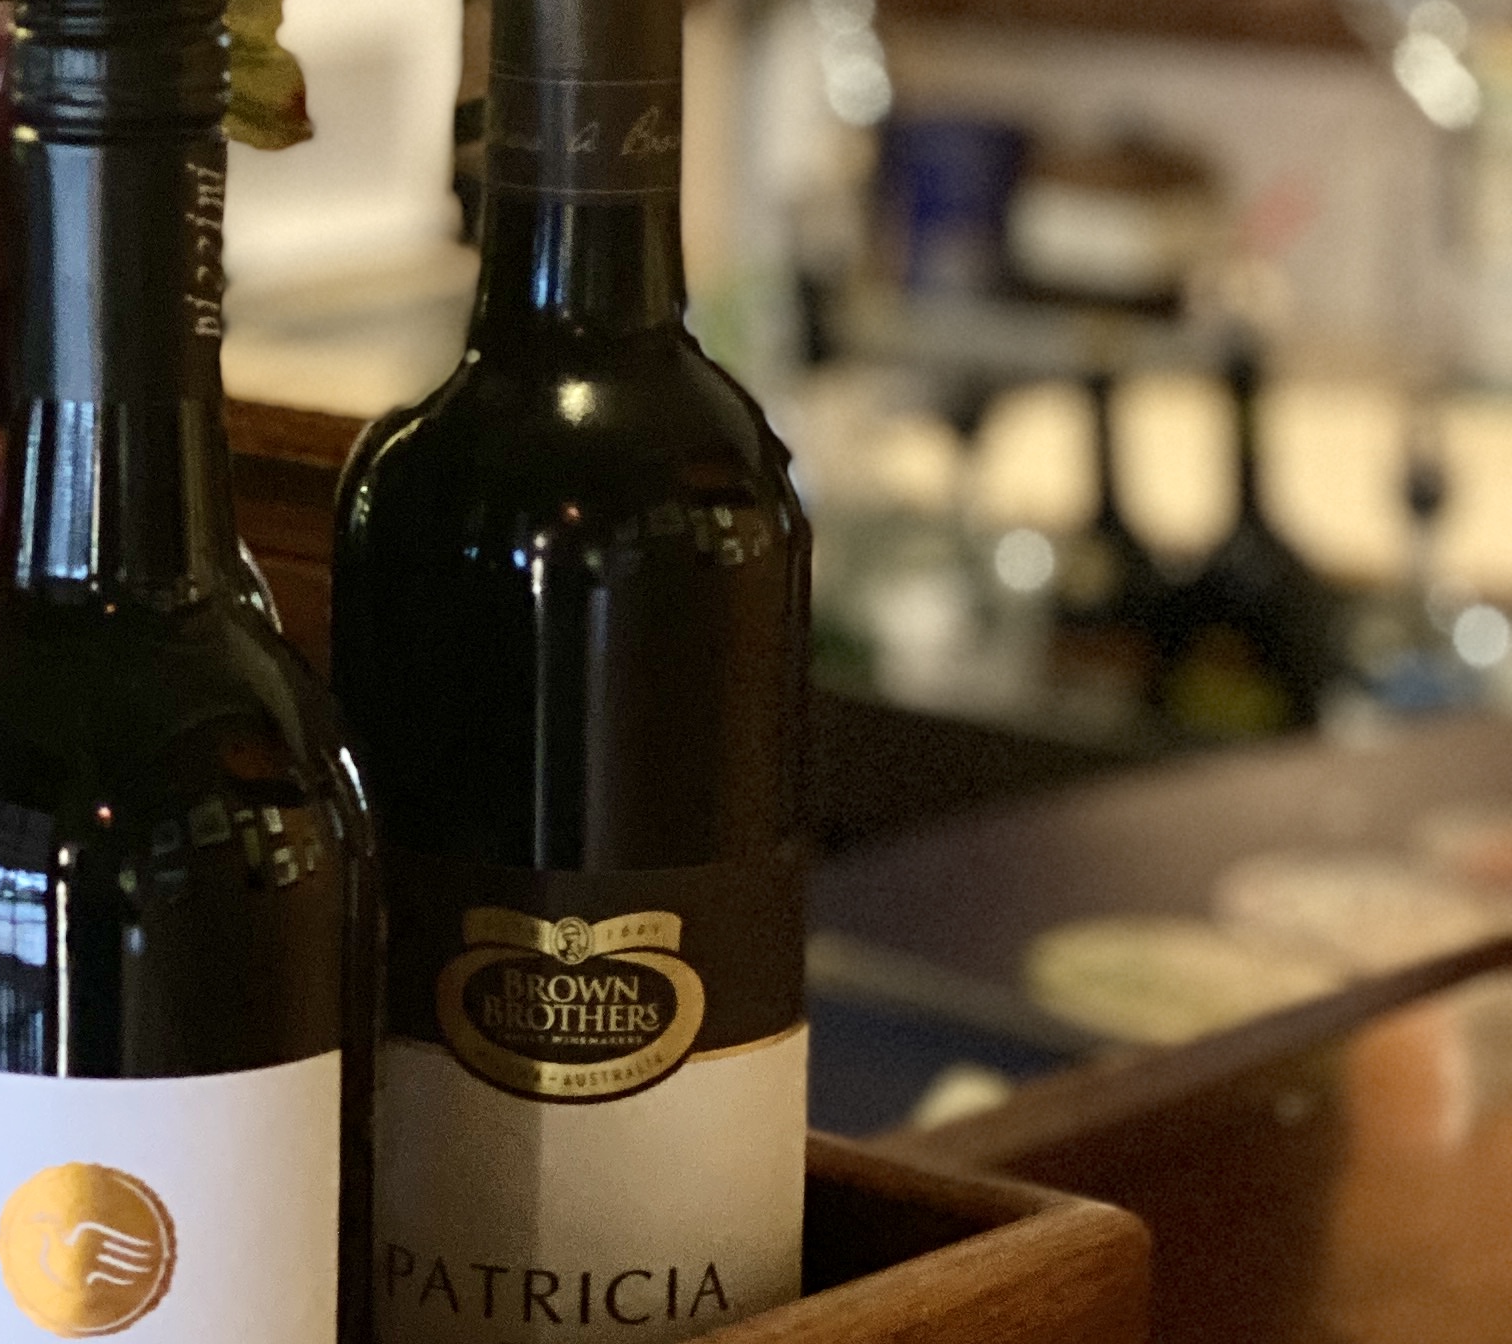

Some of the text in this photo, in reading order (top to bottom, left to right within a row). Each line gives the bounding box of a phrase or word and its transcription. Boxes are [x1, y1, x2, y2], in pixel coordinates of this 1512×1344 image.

[502, 967, 640, 1004] BROWN
[483, 994, 661, 1033] BROTHERS
[385, 1242, 730, 1326] PATRICIA
